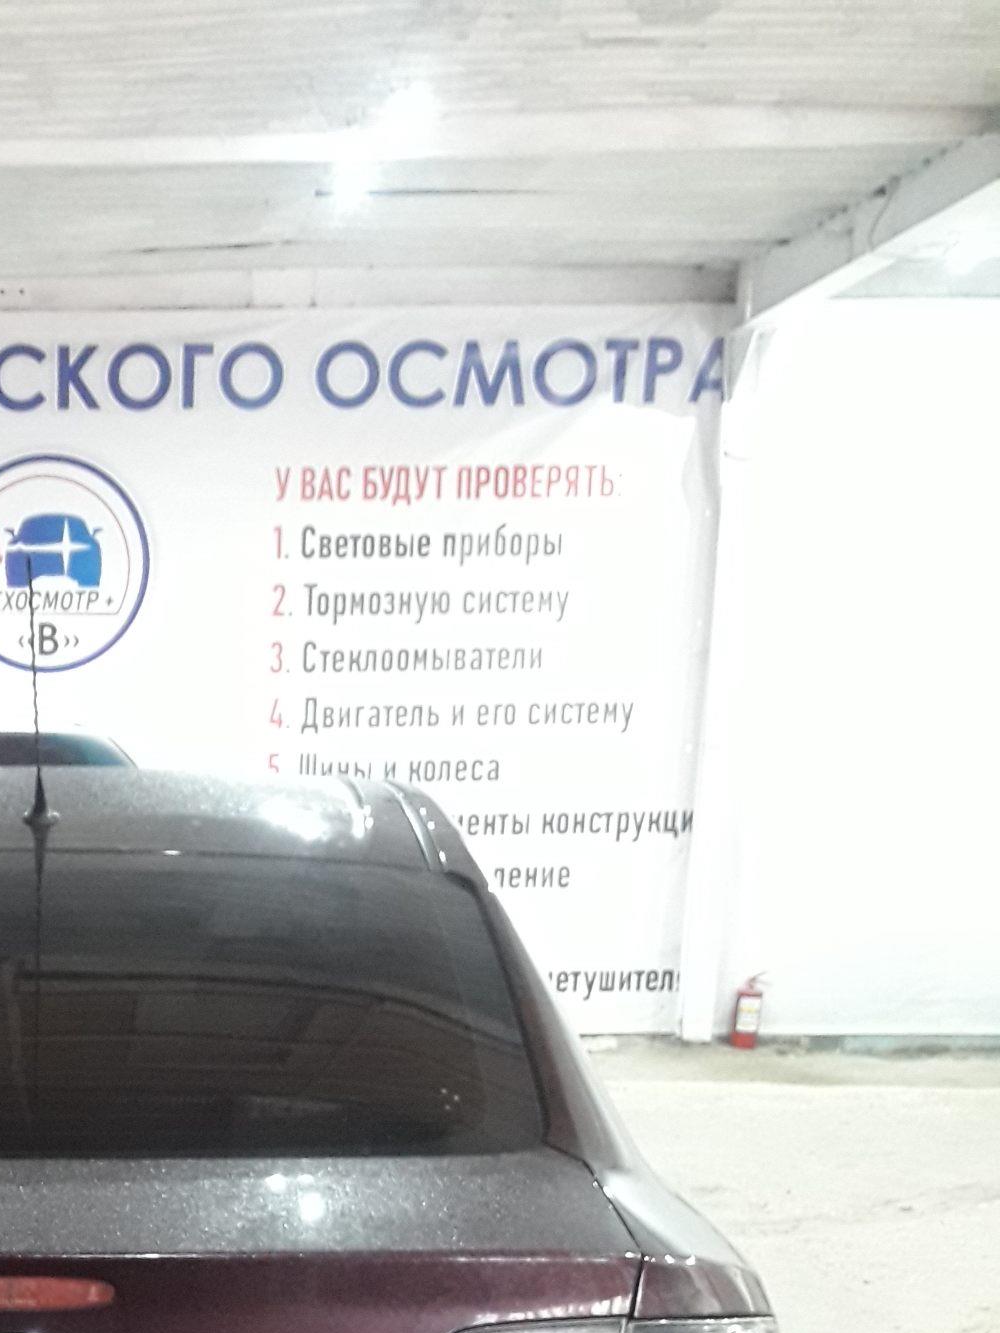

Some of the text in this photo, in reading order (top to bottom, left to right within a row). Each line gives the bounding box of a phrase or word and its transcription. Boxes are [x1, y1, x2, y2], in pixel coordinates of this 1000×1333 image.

[315, 336, 724, 411] ОСМОТРА
[275, 464, 624, 507] У ВАС БУДУТ ПРОВЕРЯТЬ:
[273, 523, 562, 566] 1. Световые приборы
[272, 583, 569, 625] 2. Тормозную систему
[270, 640, 543, 673] 3. Стеклоомыватели
[269, 697, 634, 734] 4. Двигатель и его систему
[384, 760, 397, 779] и
[408, 759, 500, 783] колеса
[548, 969, 680, 1001] етушител
